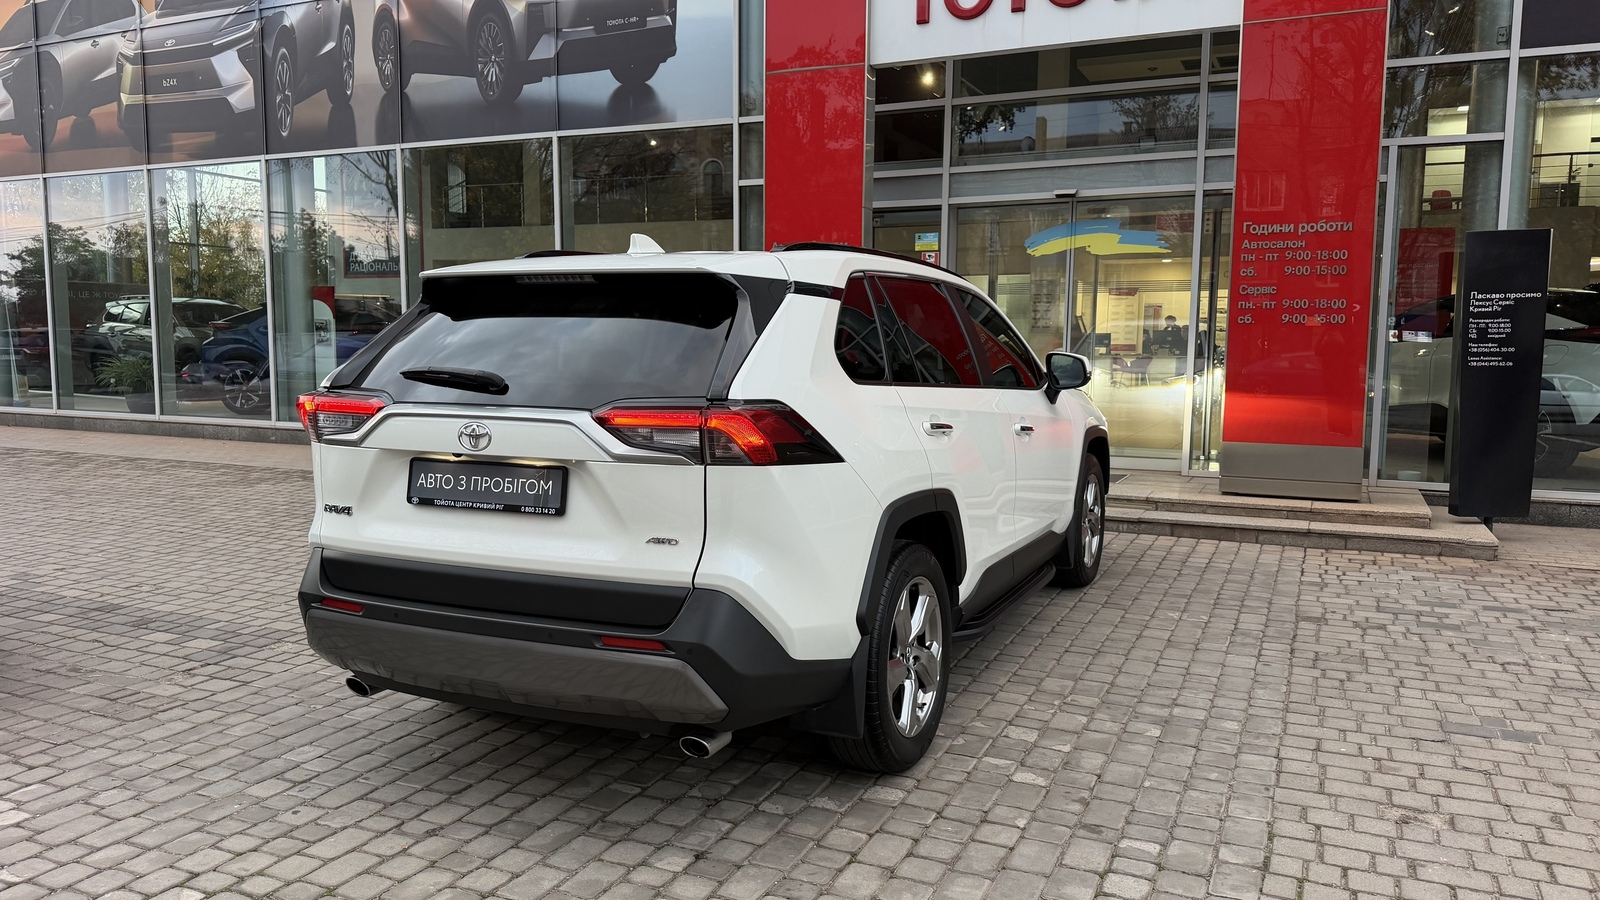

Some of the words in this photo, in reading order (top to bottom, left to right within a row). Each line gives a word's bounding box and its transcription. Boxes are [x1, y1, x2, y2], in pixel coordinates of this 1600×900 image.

[1243, 222, 1294, 235] Години
[1298, 220, 1353, 235] роботи
[1241, 239, 1306, 249] Автосалон
[350, 262, 401, 273] РАЦІОНАЛЬ
[1240, 267, 1257, 277] сб.
[1239, 285, 1277, 295] Сервіс
[1470, 291, 1505, 300] Ласкаво
[1506, 292, 1542, 300] просимо
[1237, 314, 1255, 324] сб.
[417, 473, 454, 489] АВТО
[470, 476, 553, 495] ПРОБІГОМ
[323, 503, 353, 516] RAV4
[434, 499, 455, 507] ТОЙОТА
[455, 500, 473, 508] ЦЕНТР
[472, 502, 496, 510] КРИВИЙ
